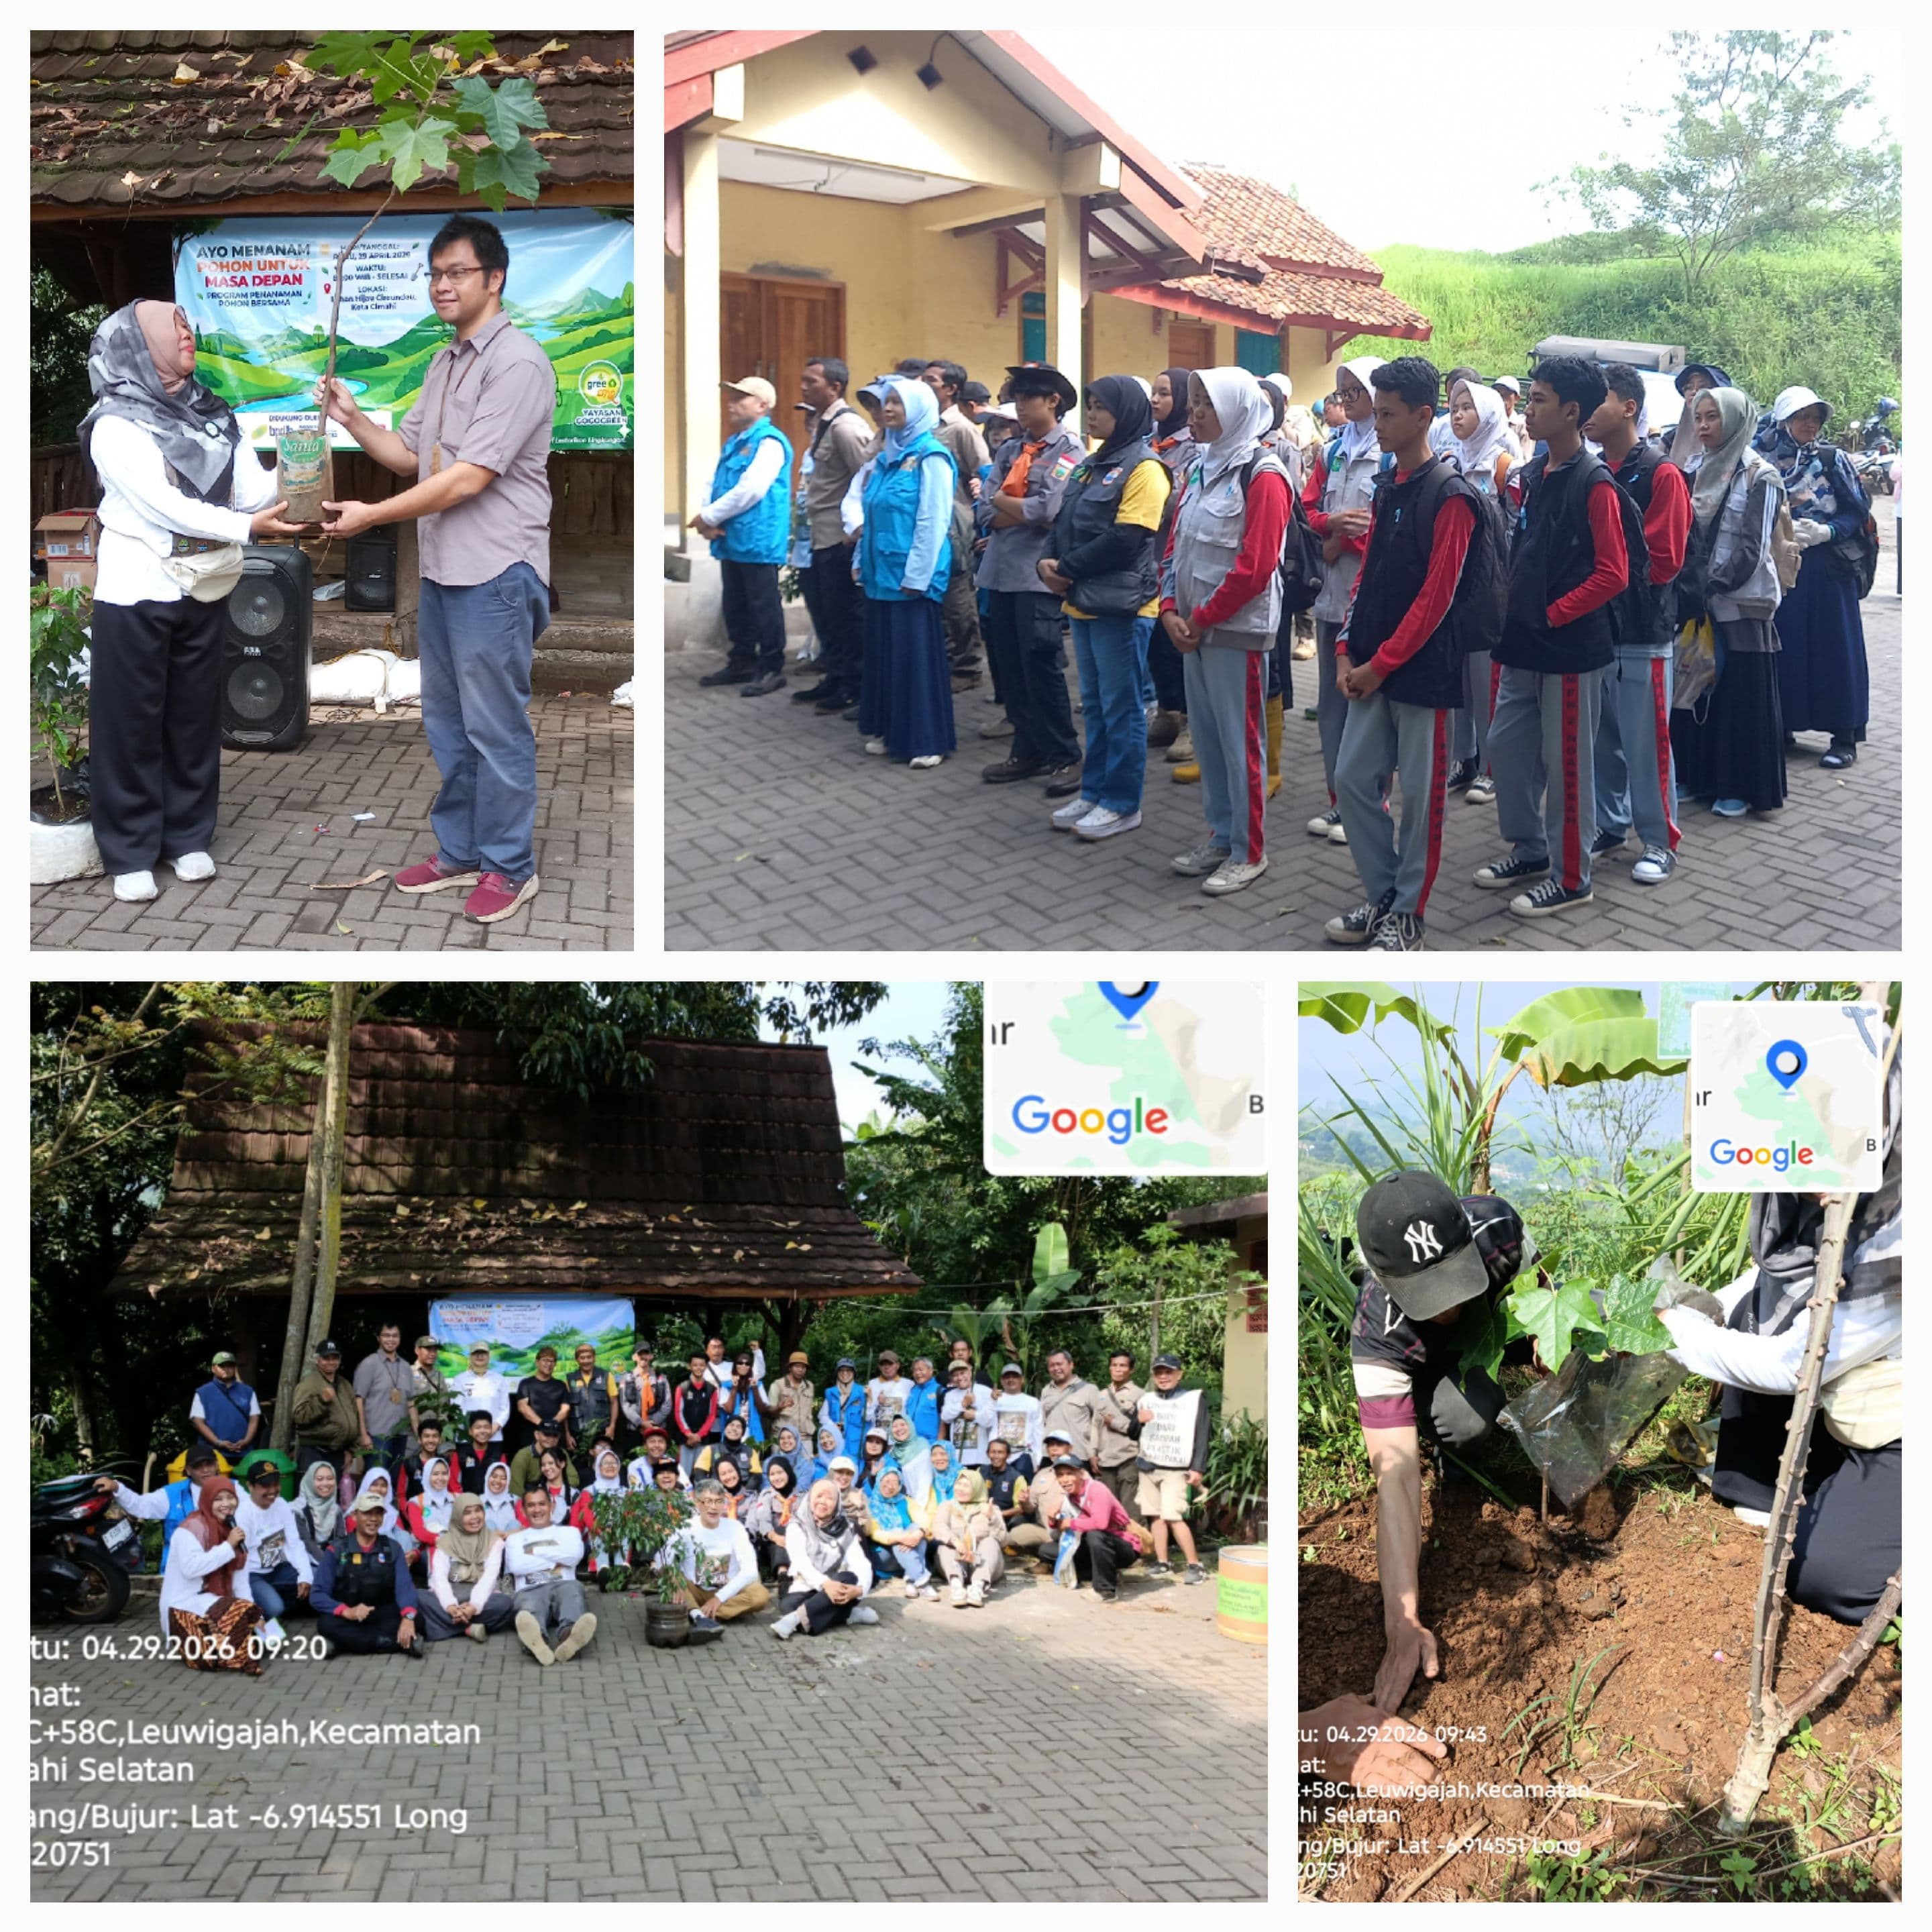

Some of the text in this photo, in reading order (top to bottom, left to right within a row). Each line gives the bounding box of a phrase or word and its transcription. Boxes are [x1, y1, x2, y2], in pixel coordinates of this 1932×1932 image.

[197, 243, 311, 258] AYO MENANAM
[197, 258, 311, 273] POHON UNTUK
[355, 264, 386, 272] WAKTU:
[376, 272, 408, 280] SELESAI
[205, 273, 303, 288] MASA DEPAN
[358, 285, 388, 293] LOKASI:
[206, 290, 302, 299] PROGRAM PENANAMAN
[219, 299, 290, 307] POHON BERSAMA
[370, 302, 397, 310] Cimahi
[1403, 1220, 1444, 1263] NY
